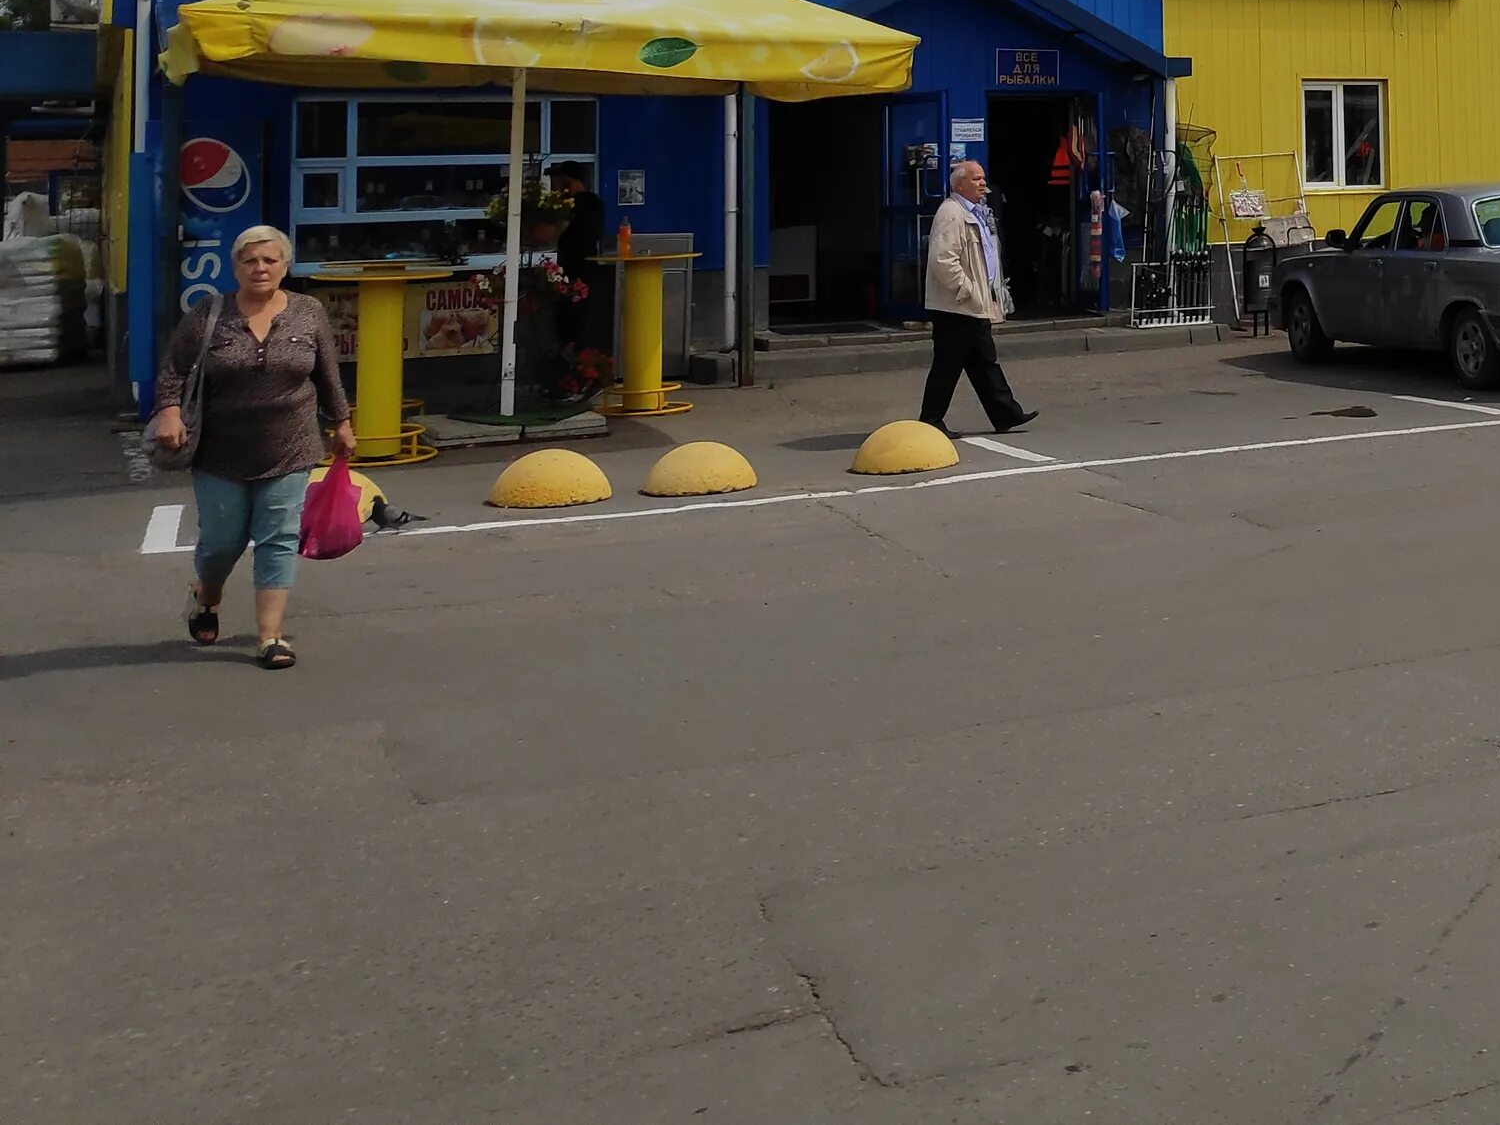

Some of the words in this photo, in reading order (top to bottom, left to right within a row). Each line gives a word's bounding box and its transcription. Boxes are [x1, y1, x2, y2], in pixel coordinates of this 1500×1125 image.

[1015, 52, 1039, 63] ВСЕ
[1013, 63, 1041, 74] ДЛЯ
[999, 74, 1056, 85] РЫБАЛКИ
[426, 288, 487, 312] САМСА
